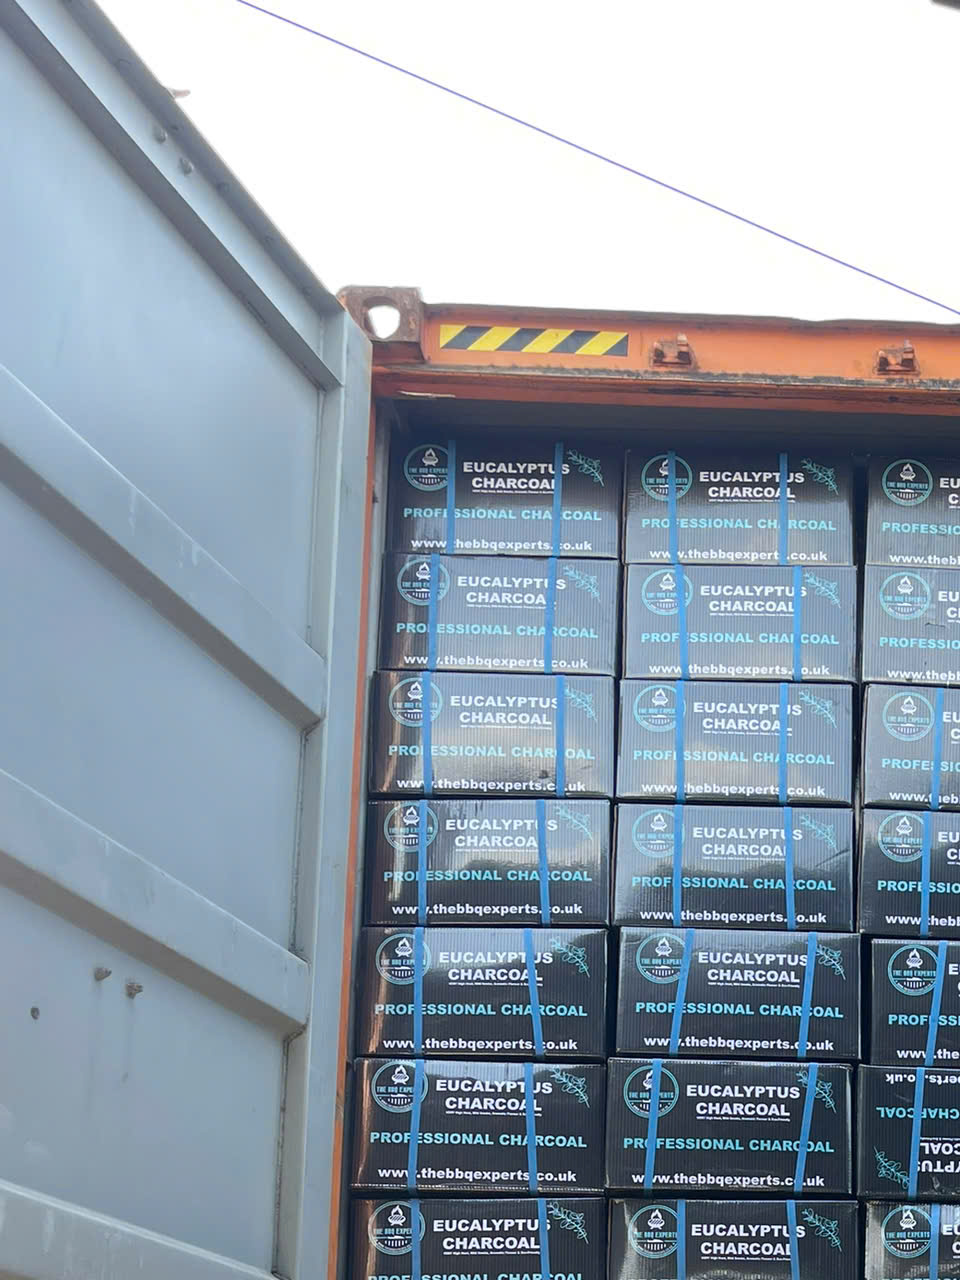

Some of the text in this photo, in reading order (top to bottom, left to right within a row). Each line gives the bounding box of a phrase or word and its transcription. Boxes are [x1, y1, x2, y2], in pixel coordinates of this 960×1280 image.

[521, 509, 602, 521] CHACOAL
[641, 517, 836, 530] PROESSIONAL CHRCOAL
[465, 591, 557, 605] CHARCOA
[395, 622, 512, 635] PROESSIONAL
[640, 632, 754, 643] PROFSSIONAL
[459, 711, 552, 725] CHARCOAL
[388, 744, 595, 759] PROESSIONAL CHAROAL
[632, 749, 749, 762] PROFSSIONAL
[396, 777, 586, 792] ww.thebbqexperts.c.uk
[445, 818, 558, 831] EUCALYPTS
[454, 835, 548, 847] CHARCOA
[701, 843, 793, 857] CHARCOA
[506, 869, 592, 881] CHACOAL
[631, 876, 836, 891] PROFSSIONAL CHACOAL
[706, 968, 800, 983] CHARCOAL
[374, 1003, 496, 1015] PROFSSIONAL
[635, 1001, 844, 1017] PROFSSIONAL CHAROAL
[686, 1084, 800, 1099] EUCALYPTUS
[695, 1102, 790, 1116] CHARCOAL
[623, 1137, 744, 1150] PRFESSIONAL
[631, 1172, 825, 1187] ww.thebbqexperts.c.uk
[432, 1218, 551, 1232] EUCALYPTU
[442, 1236, 541, 1250] CHARCOAL
